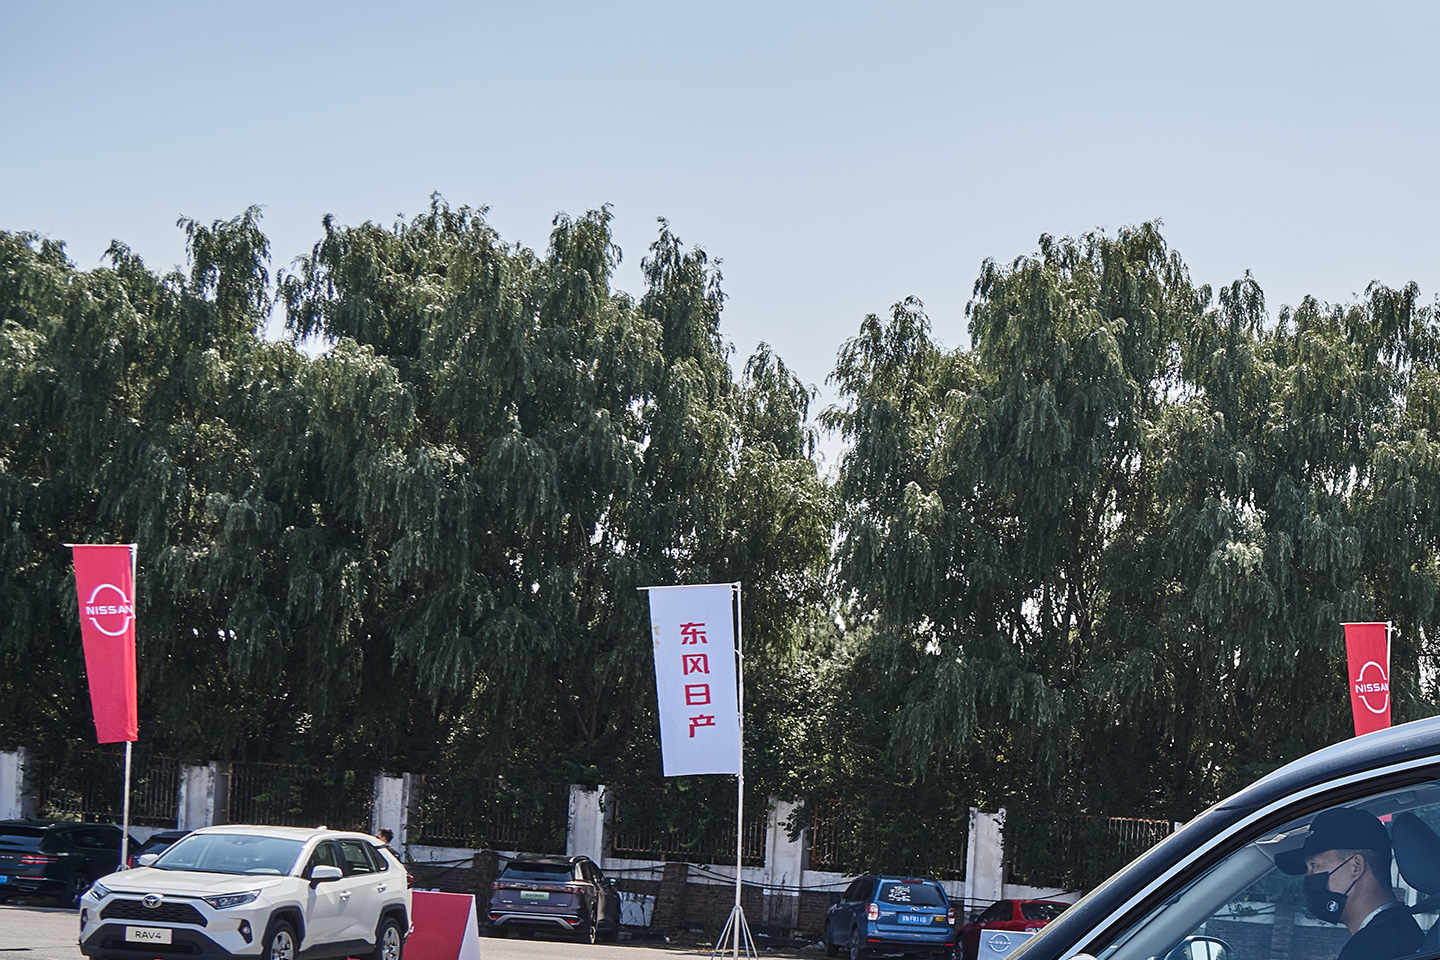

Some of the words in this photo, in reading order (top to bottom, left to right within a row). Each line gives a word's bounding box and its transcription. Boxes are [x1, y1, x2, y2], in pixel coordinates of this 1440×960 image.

[85, 605, 133, 615] NISSAN
[680, 622, 716, 738] 东风日产
[1355, 683, 1389, 693] NISSAN
[135, 931, 161, 939] RAV4
